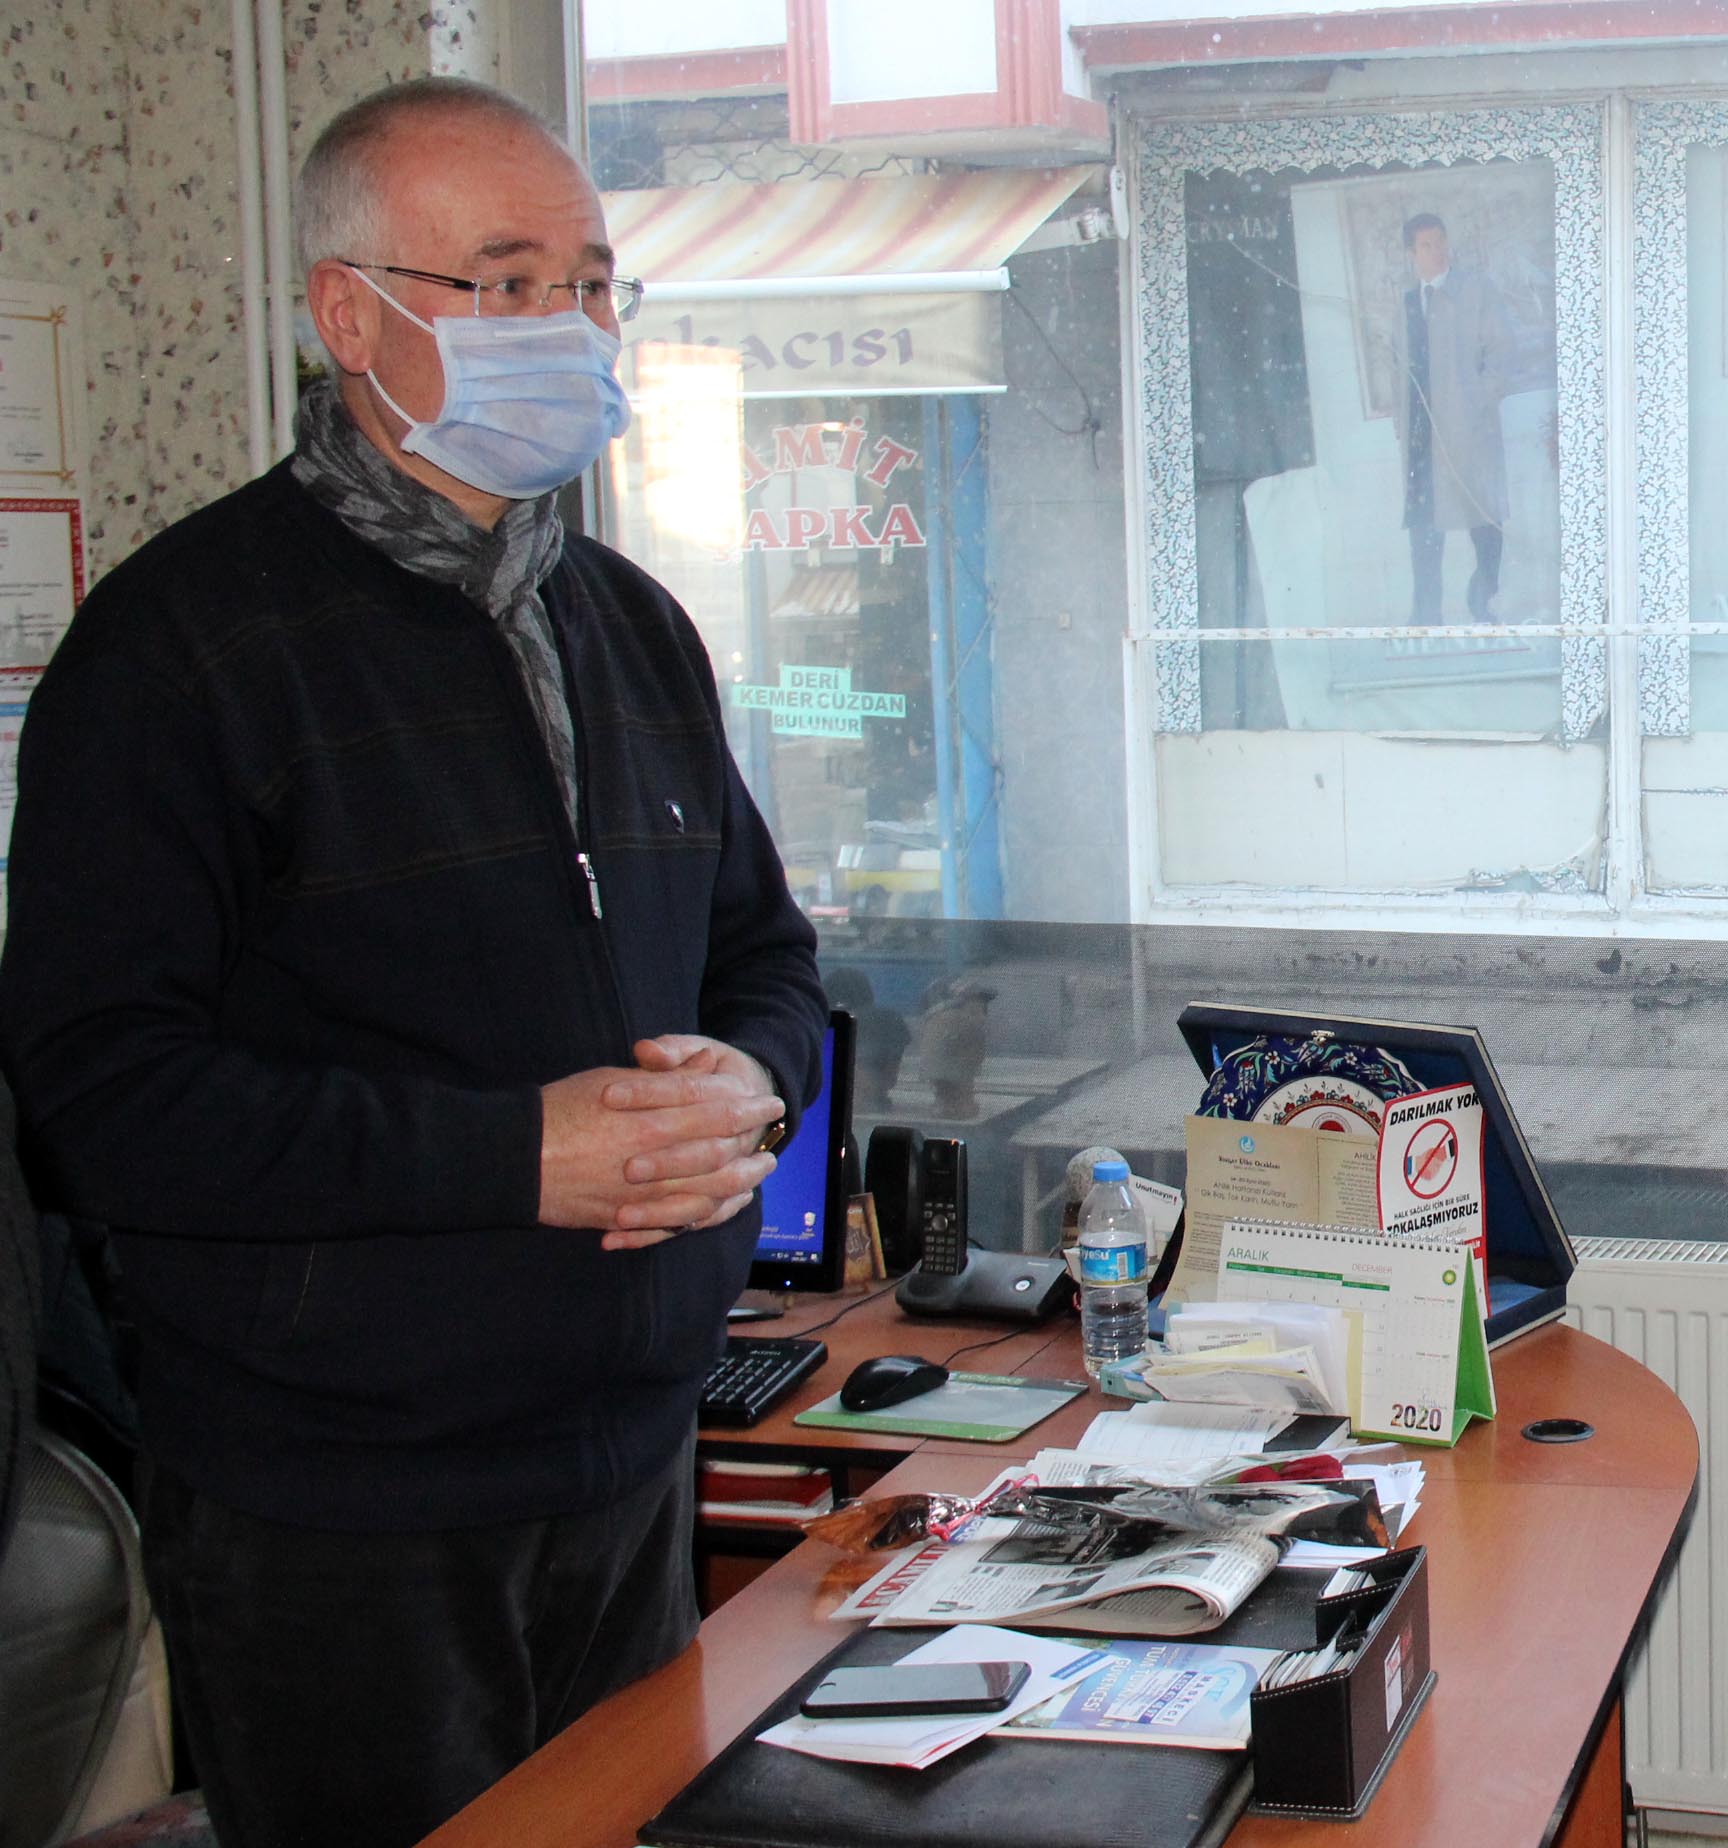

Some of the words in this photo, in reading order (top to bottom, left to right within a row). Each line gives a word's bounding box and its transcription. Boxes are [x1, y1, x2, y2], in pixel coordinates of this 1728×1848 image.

[790, 670, 840, 690] DERİ
[739, 688, 813, 709] KEMER
[773, 713, 859, 733] BULUNUR
[1389, 1097, 1454, 1126] DARILMAK
[1227, 1247, 1270, 1262] ARALIK
[1351, 1263, 1393, 1275] DECEMBER
[1390, 1403, 1442, 1432] 2020
